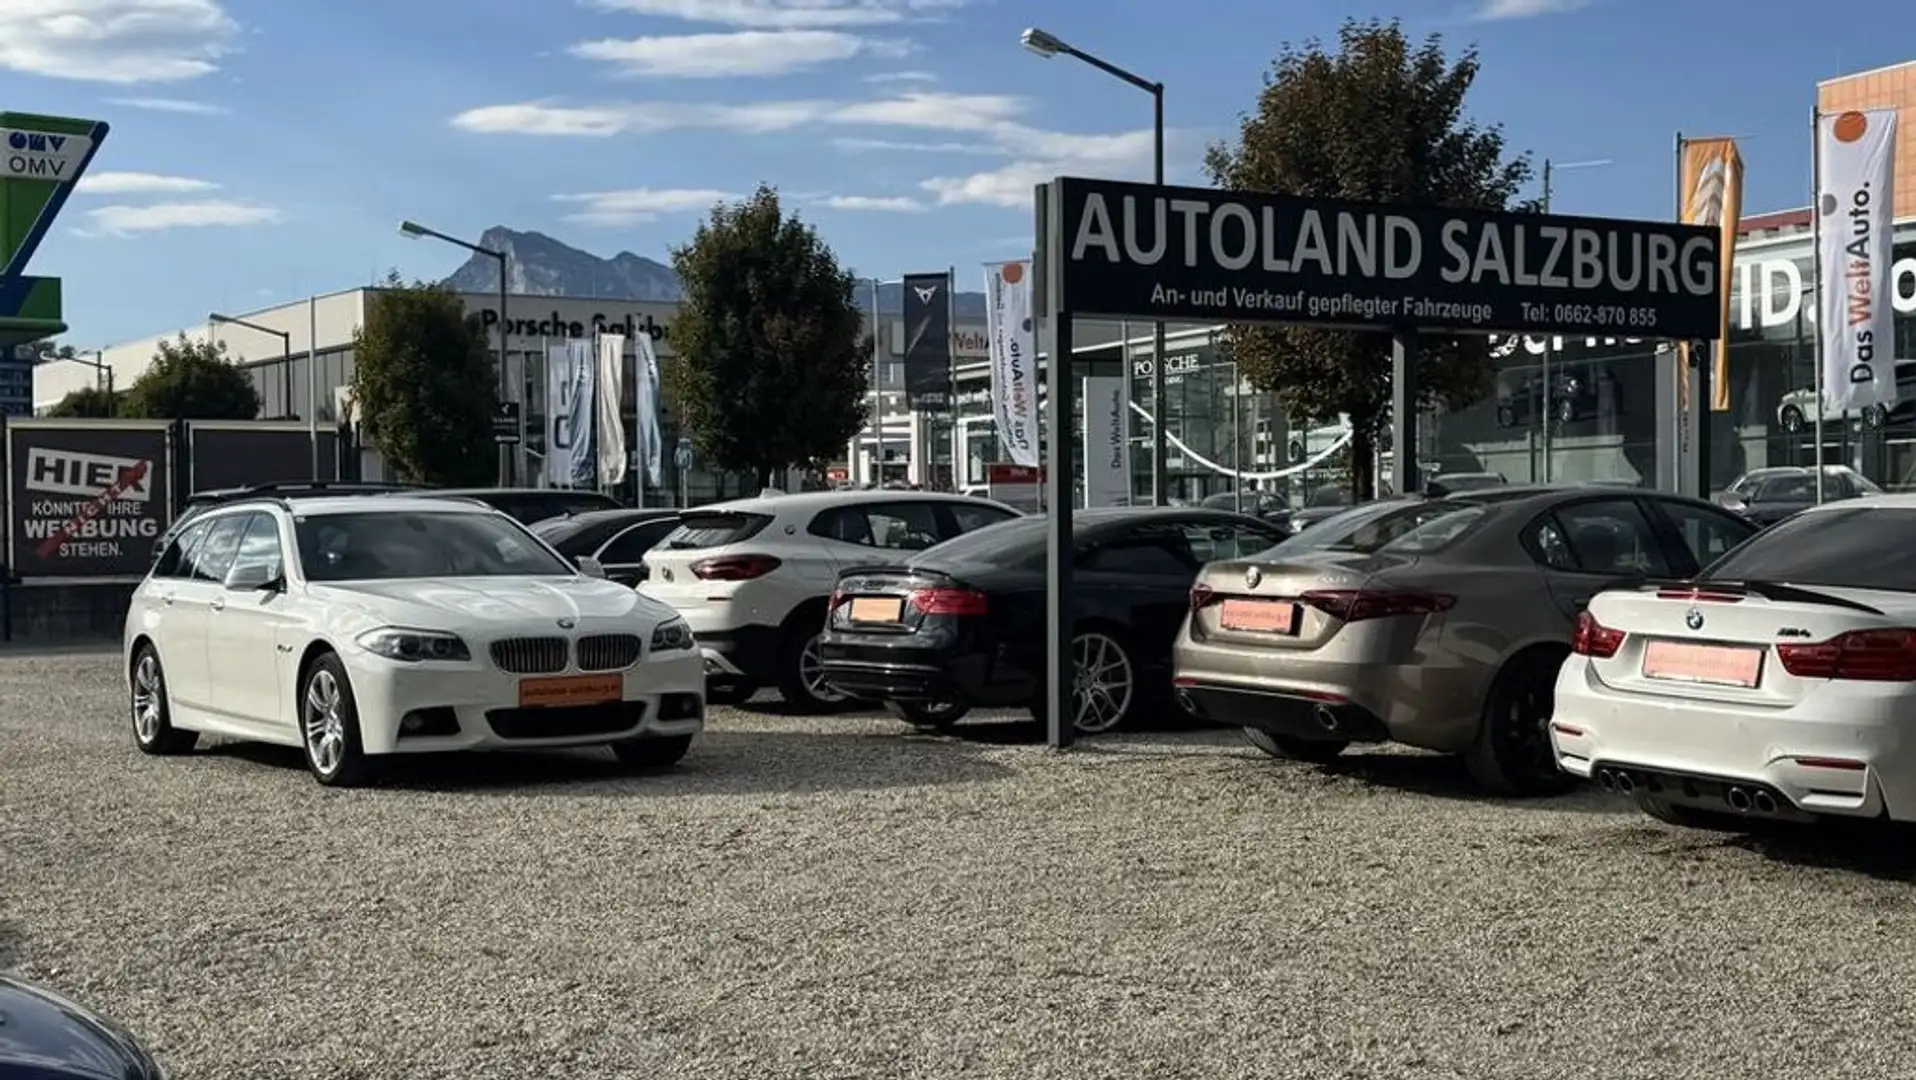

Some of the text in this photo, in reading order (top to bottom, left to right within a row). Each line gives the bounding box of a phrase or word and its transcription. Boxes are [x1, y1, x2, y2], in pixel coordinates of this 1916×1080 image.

[9, 155, 66, 176] OMV
[1071, 192, 1714, 296] AUTOLAND SALZBURG
[1845, 181, 1874, 385] Das WeltAuto.
[1151, 283, 1657, 327] An- und Verkauf gepflegter Fahrzeuge Tel: 0662-870 855
[108, 502, 142, 516] IHRE
[59, 542, 123, 558] STEHEN.
